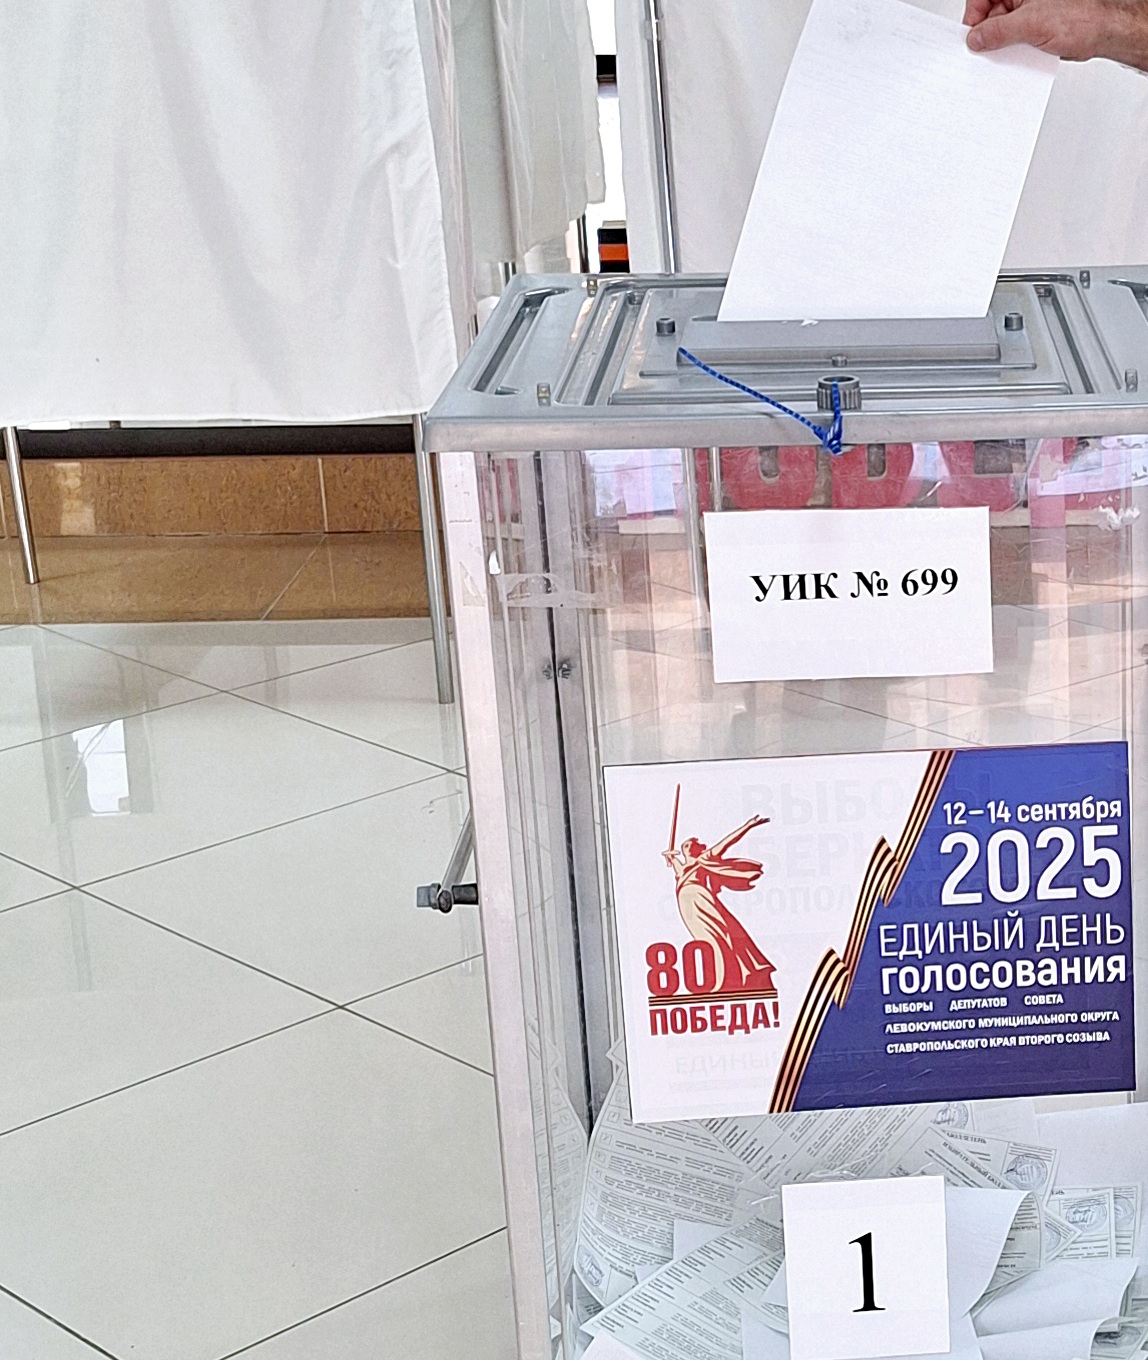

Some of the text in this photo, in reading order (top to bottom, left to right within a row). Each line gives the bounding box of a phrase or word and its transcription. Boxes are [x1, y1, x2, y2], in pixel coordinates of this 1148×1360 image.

[749, 567, 959, 602] УИК № 699
[1016, 796, 1123, 824] сентября
[939, 824, 1123, 907] 2025
[878, 910, 1125, 961] ЕДИНЫЙ ДЕНЬ
[645, 939, 718, 997] 80
[649, 1001, 781, 1037] ПОБЕДА!
[884, 993, 1064, 1015] ВЫБОРЫ ДЕПУТАТОВ СОВЕТА
[884, 1010, 1120, 1035] ЛЕВОКУМСКОГО МУНИЦИПАЛЬНОГО ОКРУГА
[886, 1030, 1111, 1054] СТАВРОПОЛЬСКОГО КРАЯ ВТОРОГО СОЗЫВА
[848, 1231, 886, 1313] 1
